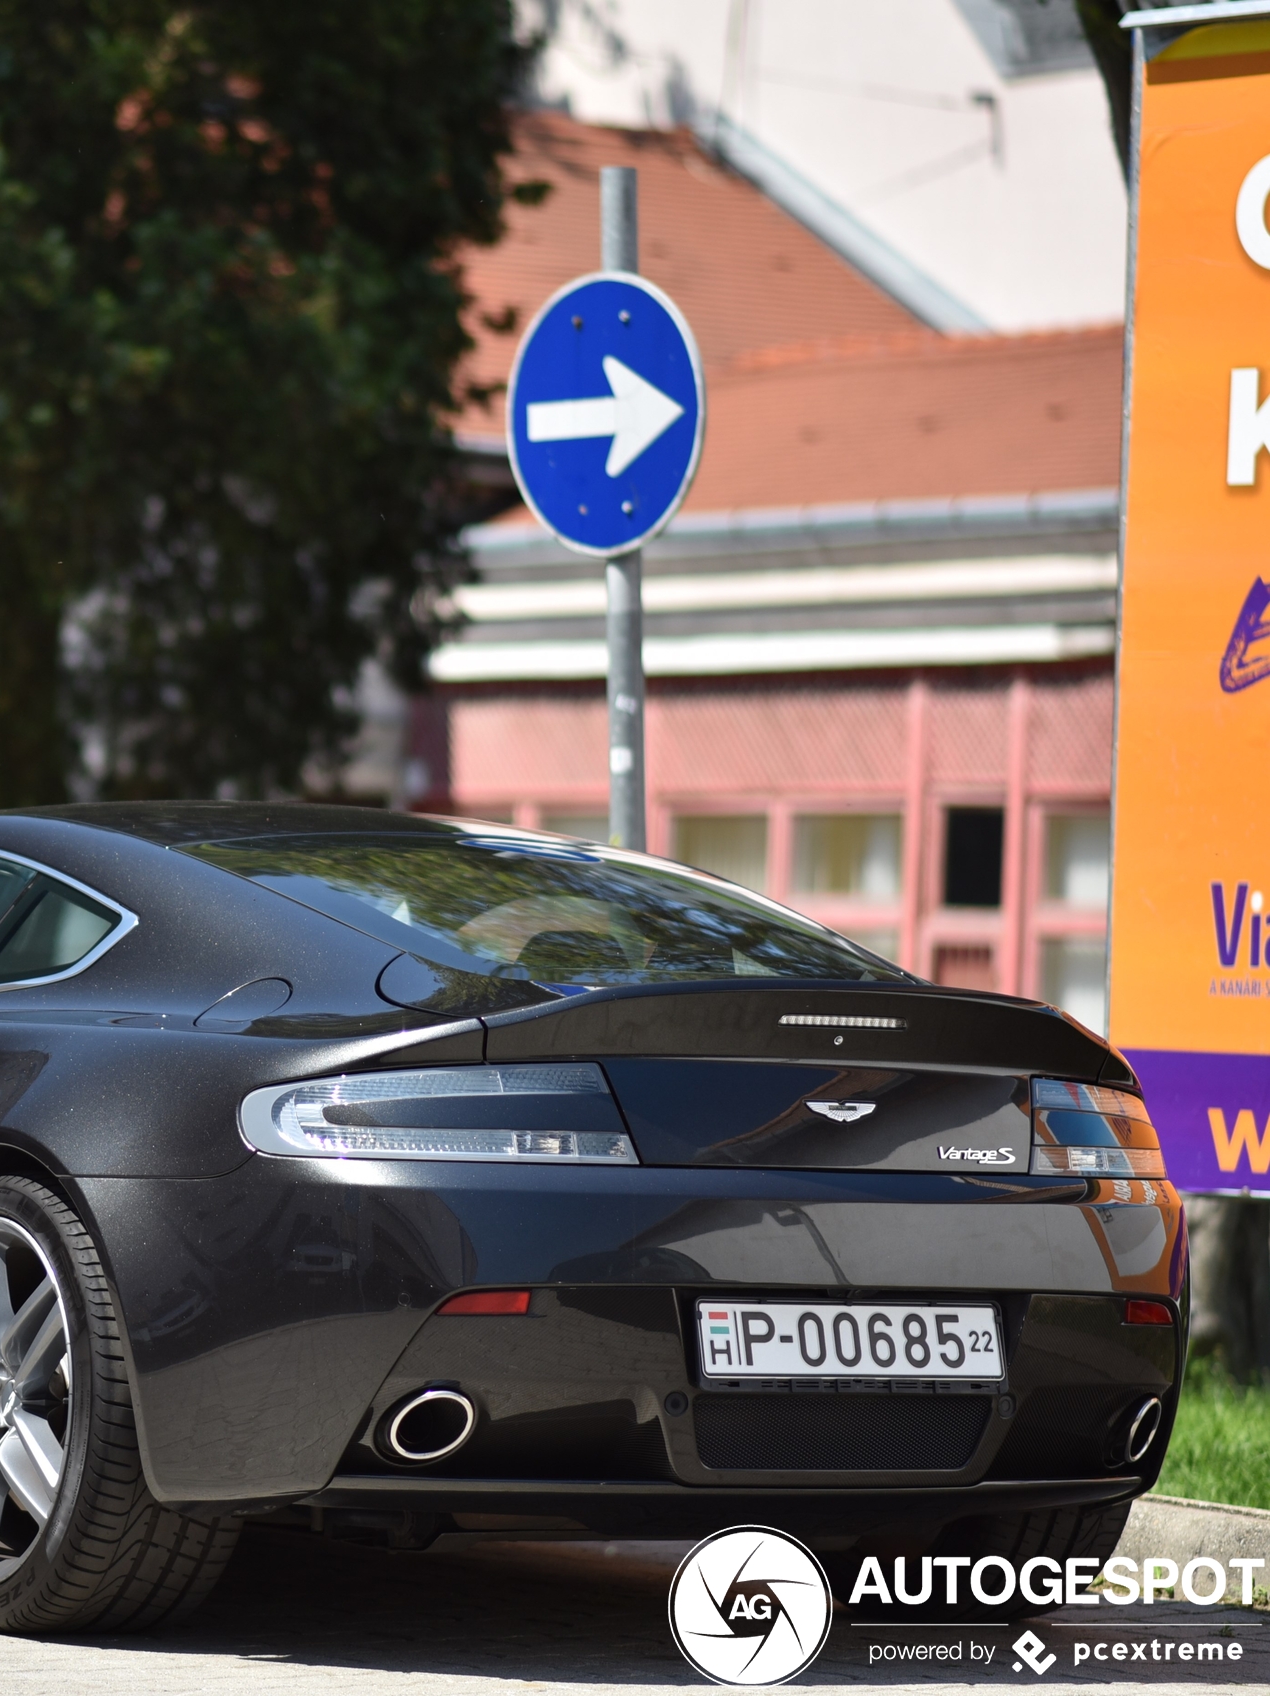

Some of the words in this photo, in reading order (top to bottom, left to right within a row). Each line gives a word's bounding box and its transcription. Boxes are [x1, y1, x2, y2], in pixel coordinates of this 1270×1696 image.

[1211, 882, 1270, 967] Vi
[939, 1146, 997, 1164] Vantage
[709, 1340, 733, 1366] H
[740, 1311, 966, 1369] P-00685
[968, 1330, 994, 1353] 22
